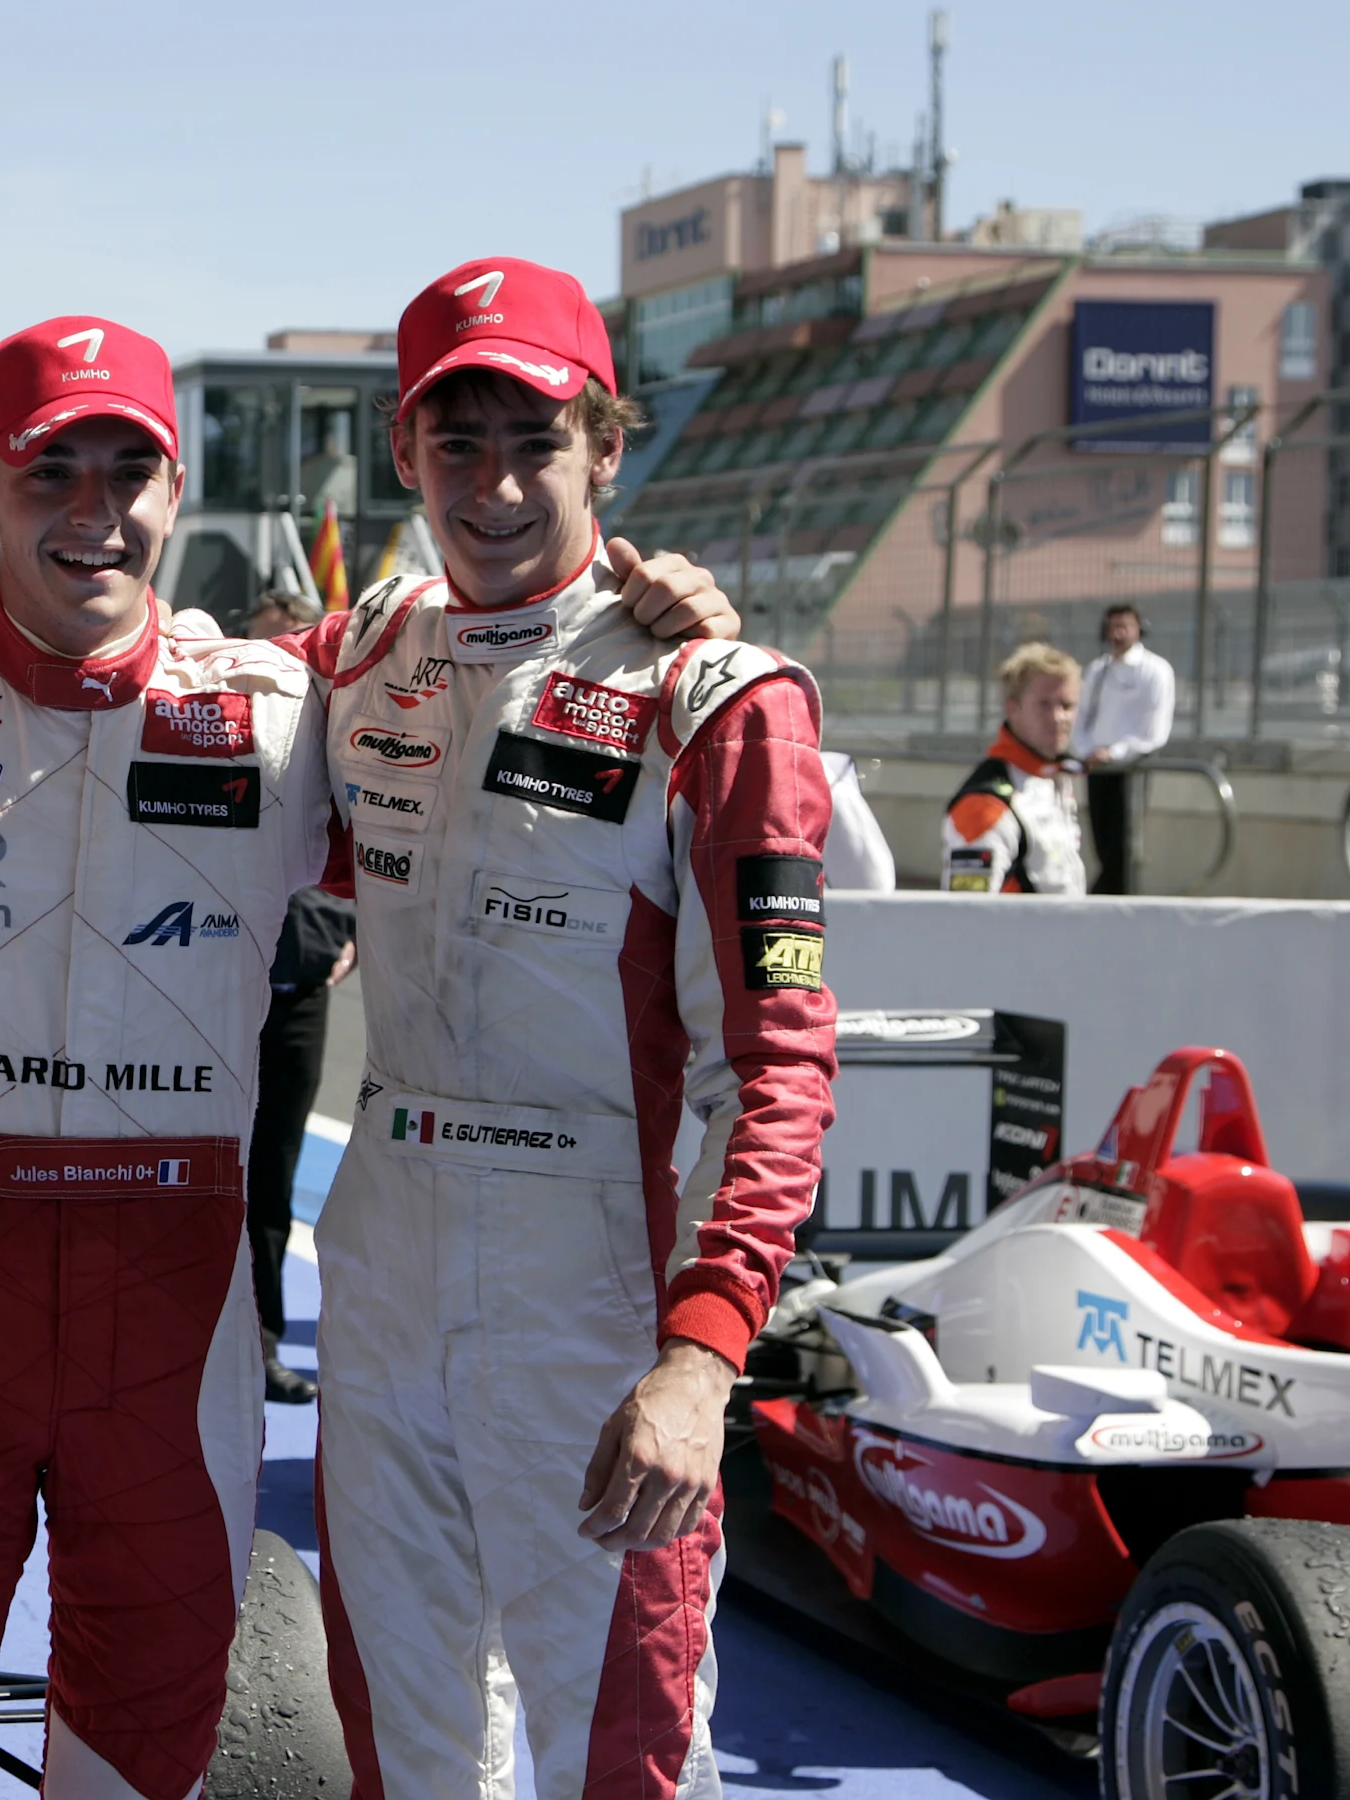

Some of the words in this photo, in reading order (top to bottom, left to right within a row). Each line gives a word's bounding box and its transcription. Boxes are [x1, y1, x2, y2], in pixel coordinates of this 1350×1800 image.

[456, 313, 503, 332] KUMHO
[61, 369, 110, 381] KUMHO
[410, 657, 456, 687] ART
[553, 681, 630, 713] auto
[155, 699, 222, 721] auto
[563, 703, 637, 729] motor
[170, 719, 237, 734] motor
[586, 721, 639, 744] sport
[192, 733, 243, 748] sport
[497, 769, 550, 793] KUMHO
[551, 783, 593, 804] TYRES
[139, 800, 187, 814] KUMHO
[190, 803, 228, 817] TYRES
[362, 790, 420, 815] TELMEX
[750, 896, 799, 910] KUMHO
[200, 914, 239, 928] SAIMA
[105, 1064, 213, 1092] MILLE
[456, 1124, 553, 1149] GUTIERREZ
[10, 1164, 58, 1181] Jules
[64, 1164, 133, 1181] Bianchi
[1136, 1332, 1296, 1418] TELMEX
